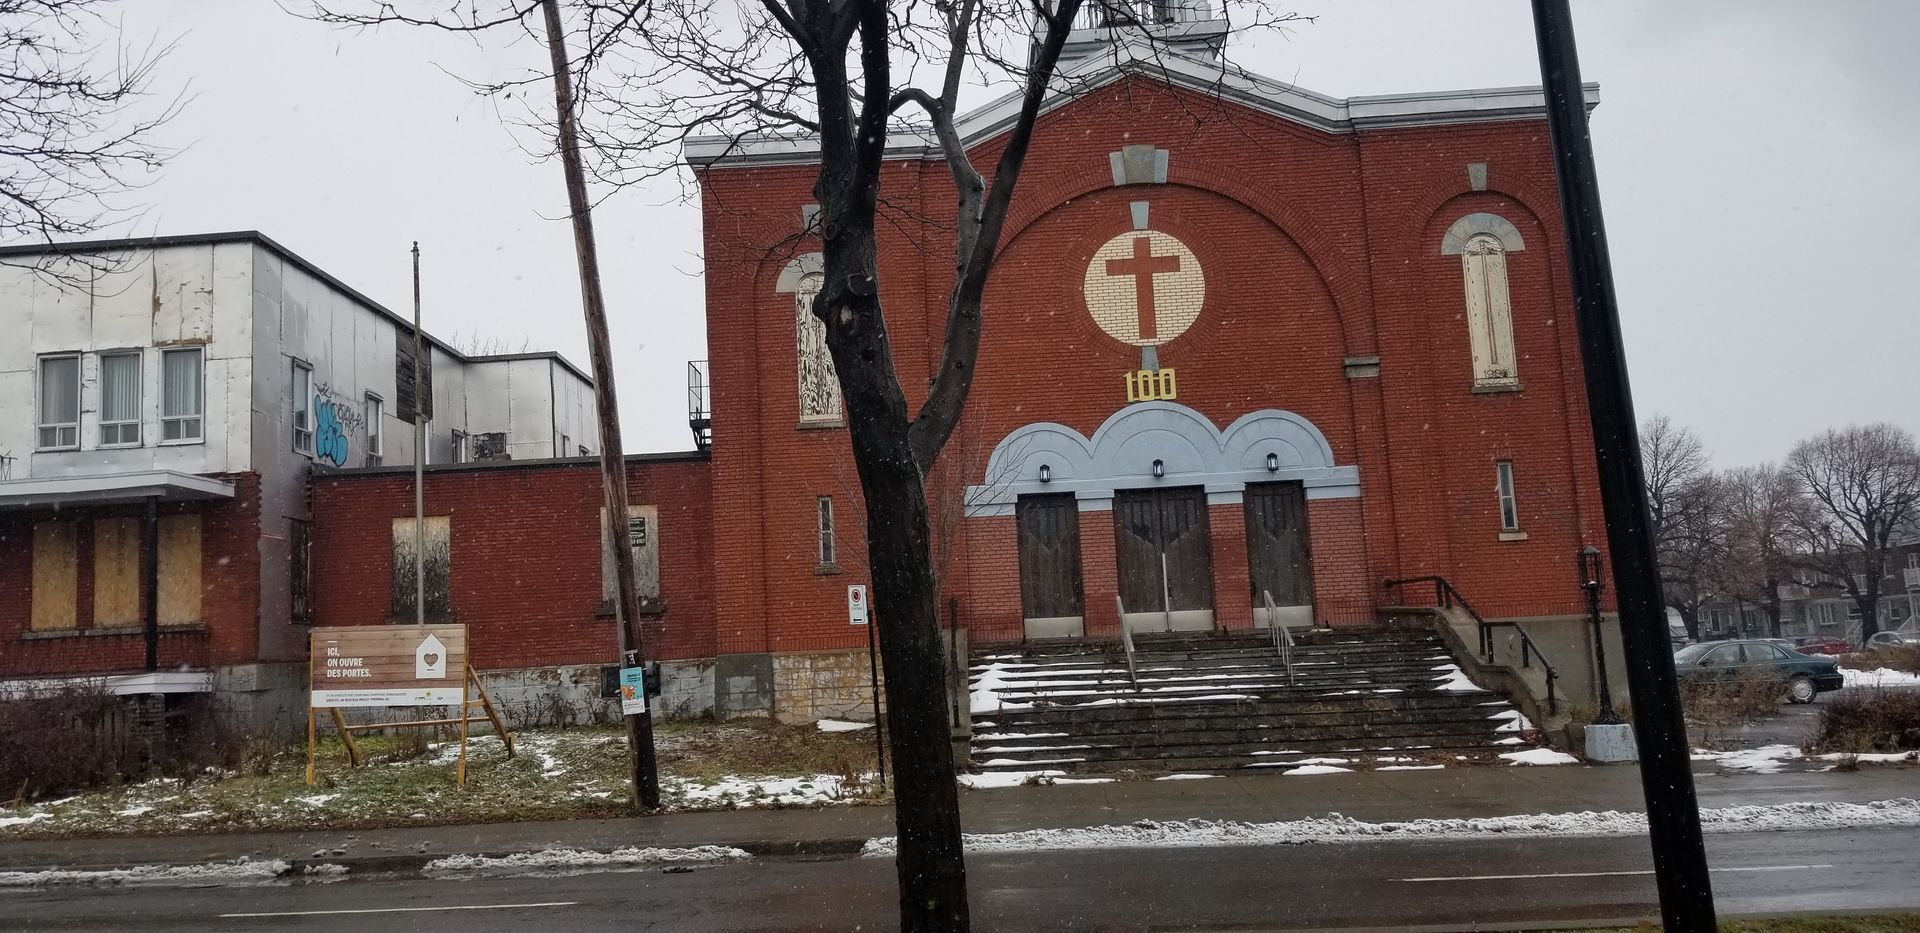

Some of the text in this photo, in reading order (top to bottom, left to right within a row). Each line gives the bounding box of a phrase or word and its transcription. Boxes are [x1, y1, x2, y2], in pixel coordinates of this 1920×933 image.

[1123, 368, 1177, 403] 100
[327, 647, 340, 657] ICI,
[327, 657, 363, 667] ON OUVRE
[327, 668, 372, 678] DES PORTES.
